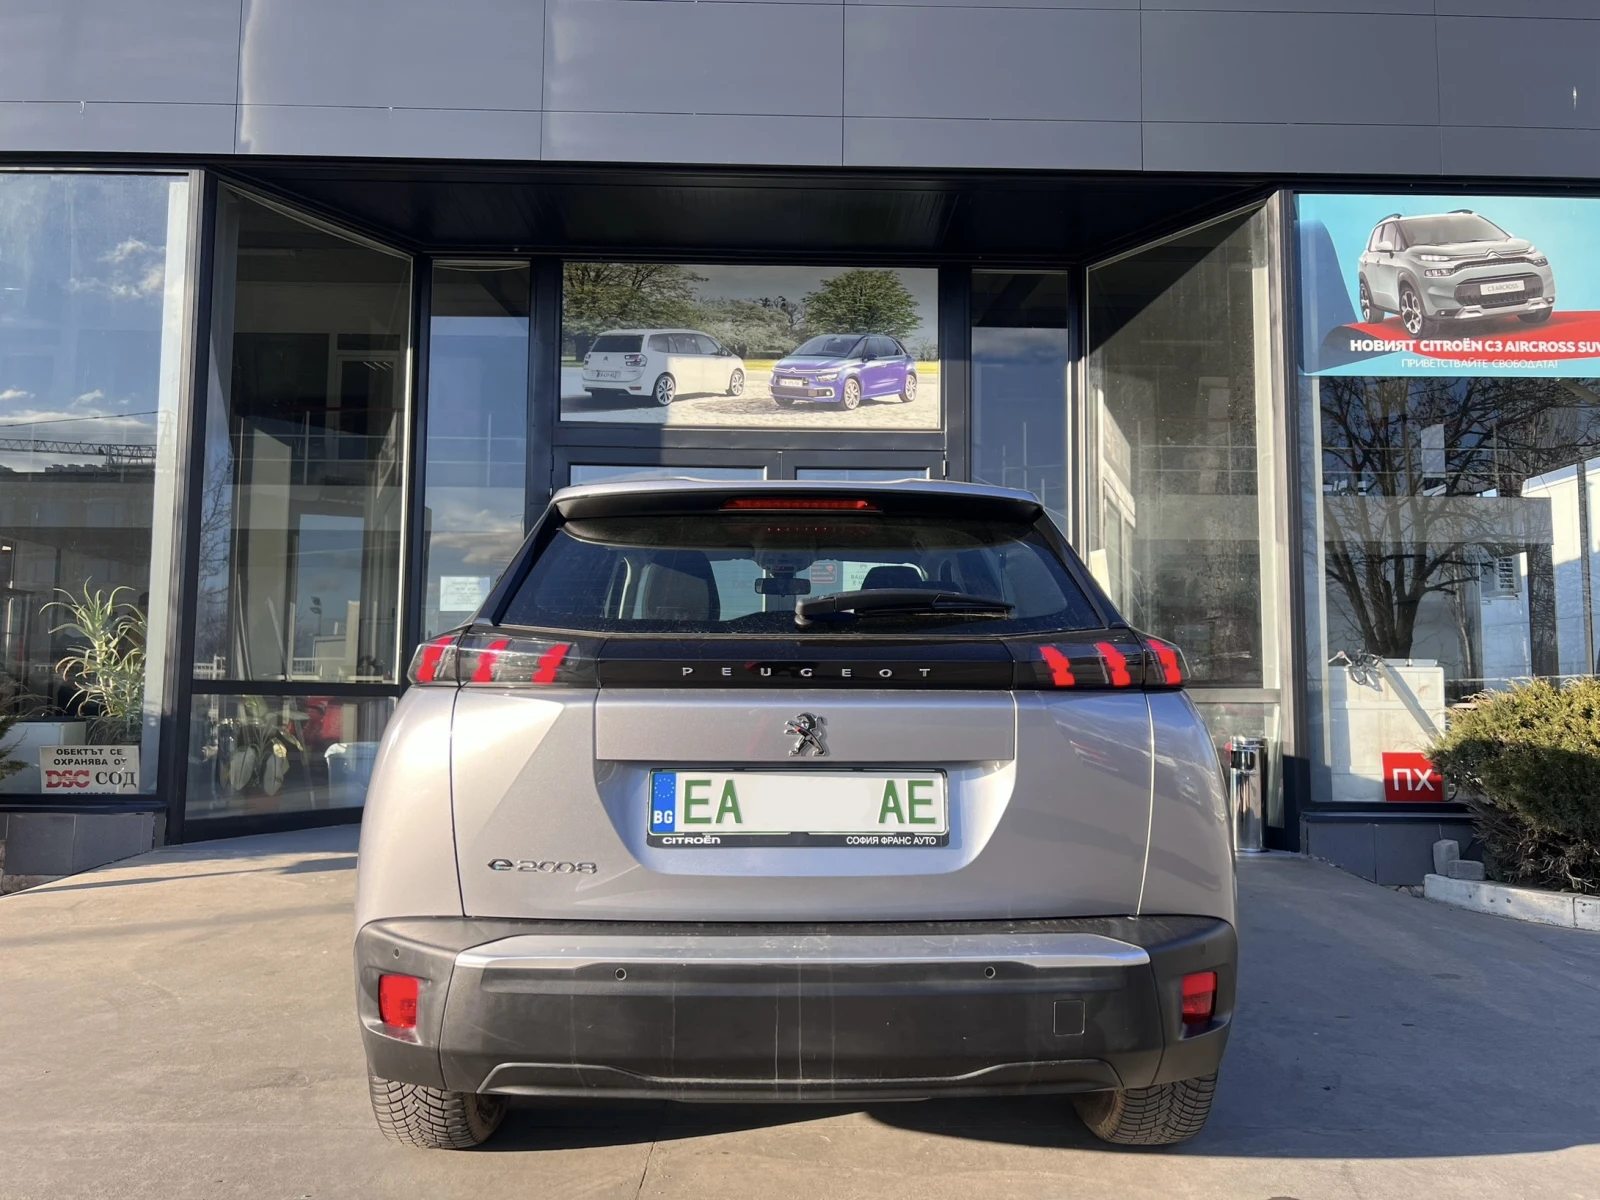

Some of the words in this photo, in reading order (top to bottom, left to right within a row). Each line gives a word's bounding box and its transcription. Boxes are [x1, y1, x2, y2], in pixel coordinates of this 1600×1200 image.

[1350, 340, 1416, 352] НОВИЯТ
[1420, 338, 1485, 353] CITROËN
[1485, 341, 1503, 353] C3
[1504, 341, 1576, 353] AIRCROSS
[1401, 357, 1488, 369] ПРИВЕТСТВАЙТЕ
[1492, 359, 1558, 369] СВОБОДАТА!
[682, 667, 931, 678] PEUGEOT
[56, 748, 104, 756] ОБЕКТЪТ
[110, 748, 123, 756] СЕ
[53, 758, 108, 766] ОХРАНЯВА
[114, 758, 127, 766] ОТ
[45, 770, 91, 788] DSC
[95, 771, 137, 788] СОД
[1392, 768, 1435, 791] ПХ
[684, 779, 743, 824] EA
[878, 779, 937, 824] AE
[653, 810, 674, 824] BG
[846, 836, 879, 845] СОФИЯ
[880, 836, 912, 845] ФРАНС
[913, 836, 937, 845] АУТО
